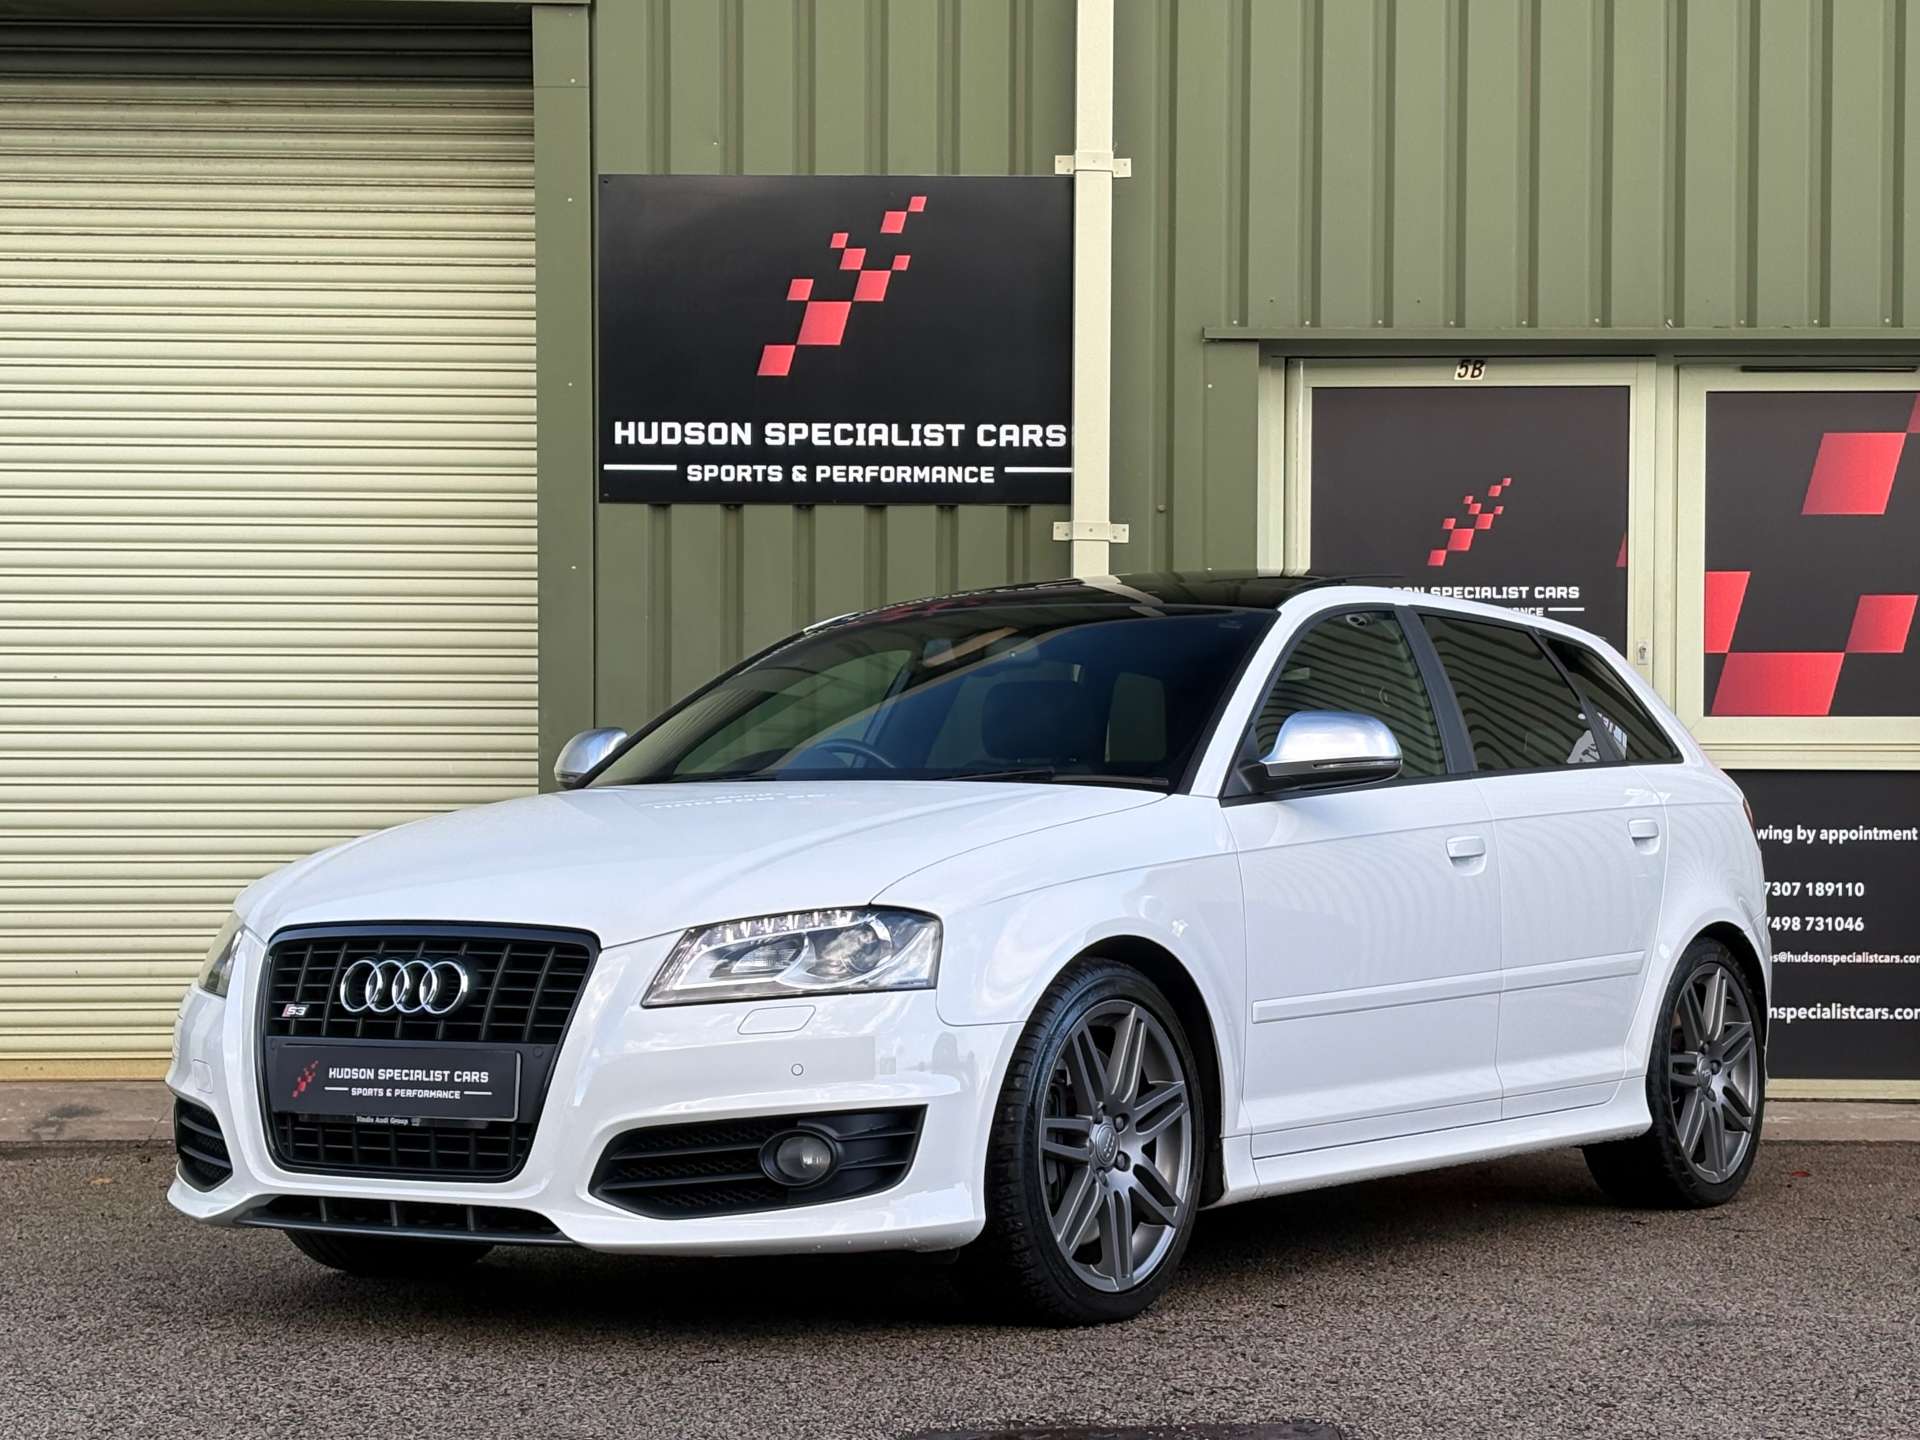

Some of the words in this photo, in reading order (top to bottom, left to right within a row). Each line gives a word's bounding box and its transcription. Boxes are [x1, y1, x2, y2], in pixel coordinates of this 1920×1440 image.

[1457, 359, 1486, 379] 5B
[614, 421, 752, 446] HUDSON
[764, 422, 965, 447] SPECIALIST
[976, 424, 1067, 447] CARS
[686, 464, 783, 482] SPORTS
[792, 465, 807, 483] &
[816, 465, 995, 484] PERFORMANCE
[1430, 586, 1529, 599] SPECIALIST
[1534, 587, 1580, 599] CARS
[1797, 825, 1816, 844] by
[1819, 826, 1918, 844] appointment
[1805, 882, 1865, 897] 189110
[1805, 916, 1865, 931] 731046
[286, 1006, 307, 1016] S3
[328, 1067, 375, 1080] HUDSON
[377, 1068, 450, 1082] SPECIALIST
[453, 1071, 489, 1083] CARS
[351, 1087, 384, 1097] SPORTS
[394, 1088, 461, 1099] PERFORMANCE
